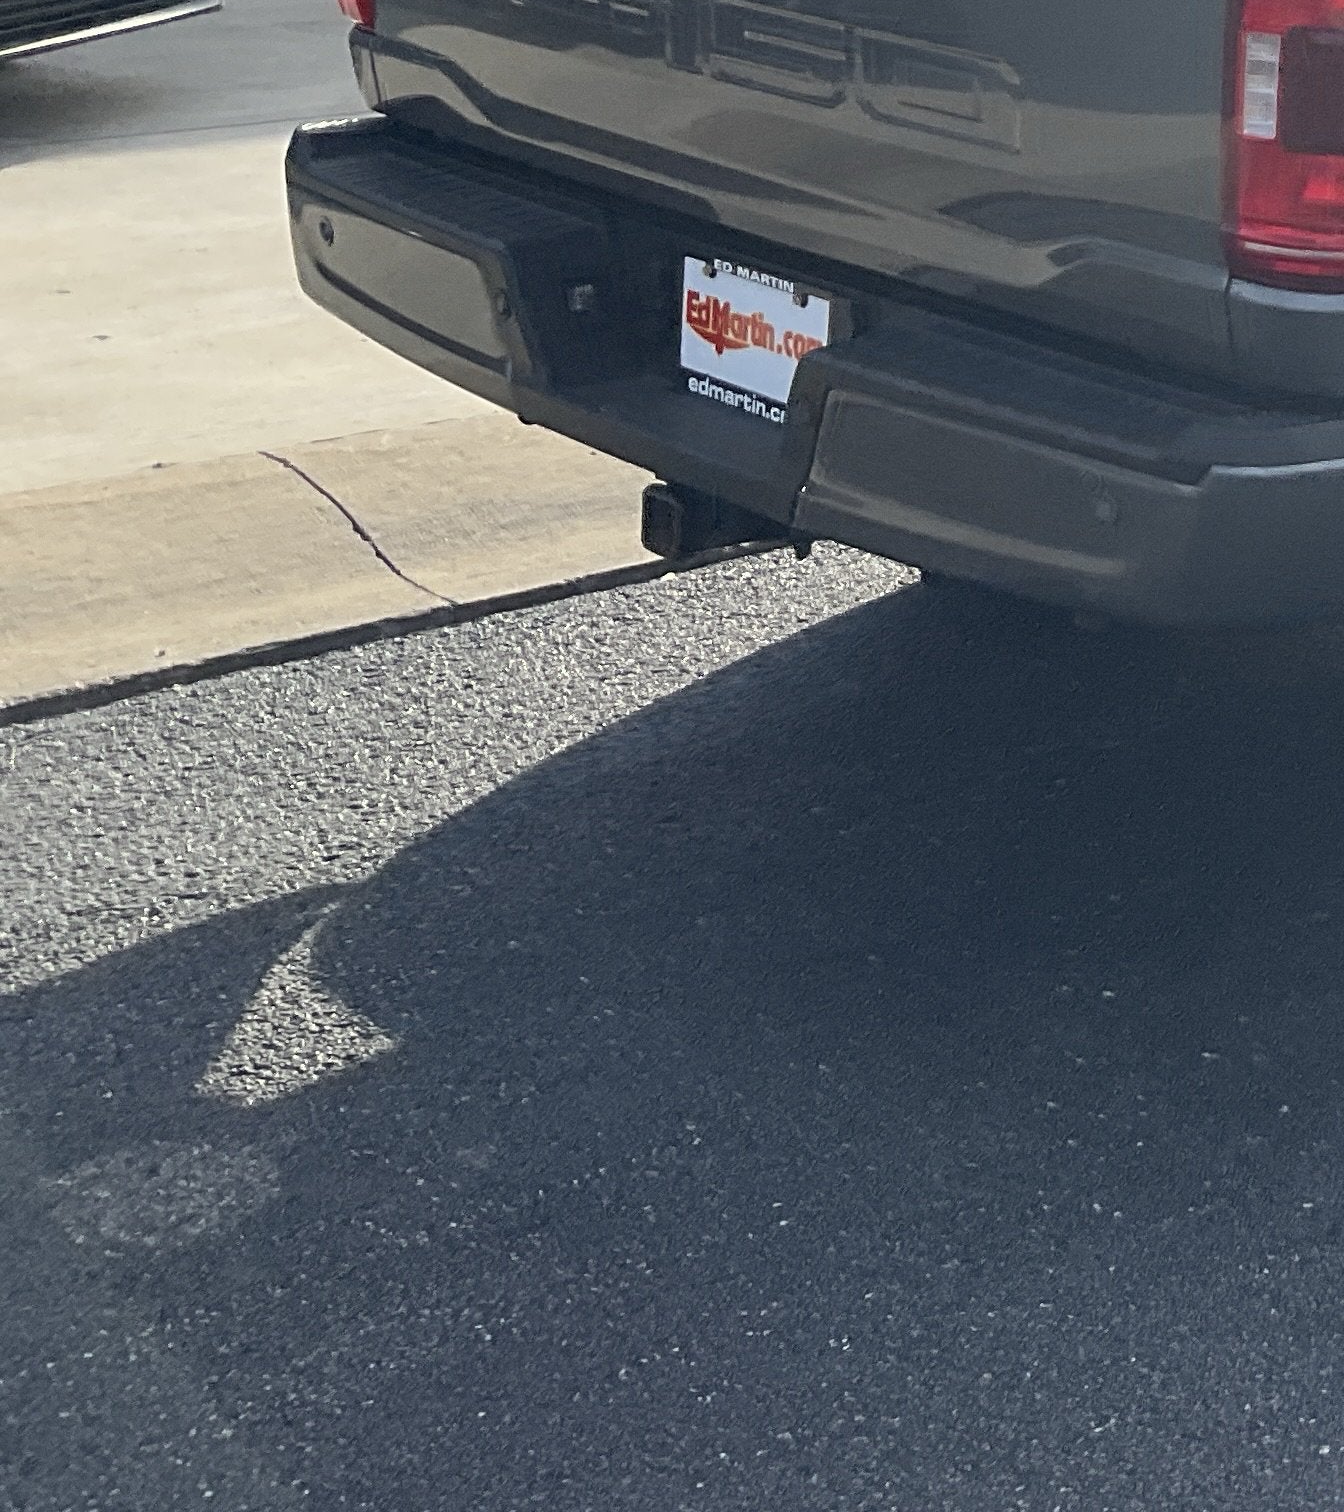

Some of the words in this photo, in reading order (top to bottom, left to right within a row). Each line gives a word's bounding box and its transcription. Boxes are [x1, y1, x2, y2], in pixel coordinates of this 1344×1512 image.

[713, 258, 733, 273] ED
[737, 265, 794, 293] MARTIN
[687, 375, 786, 424] edmartin.c
